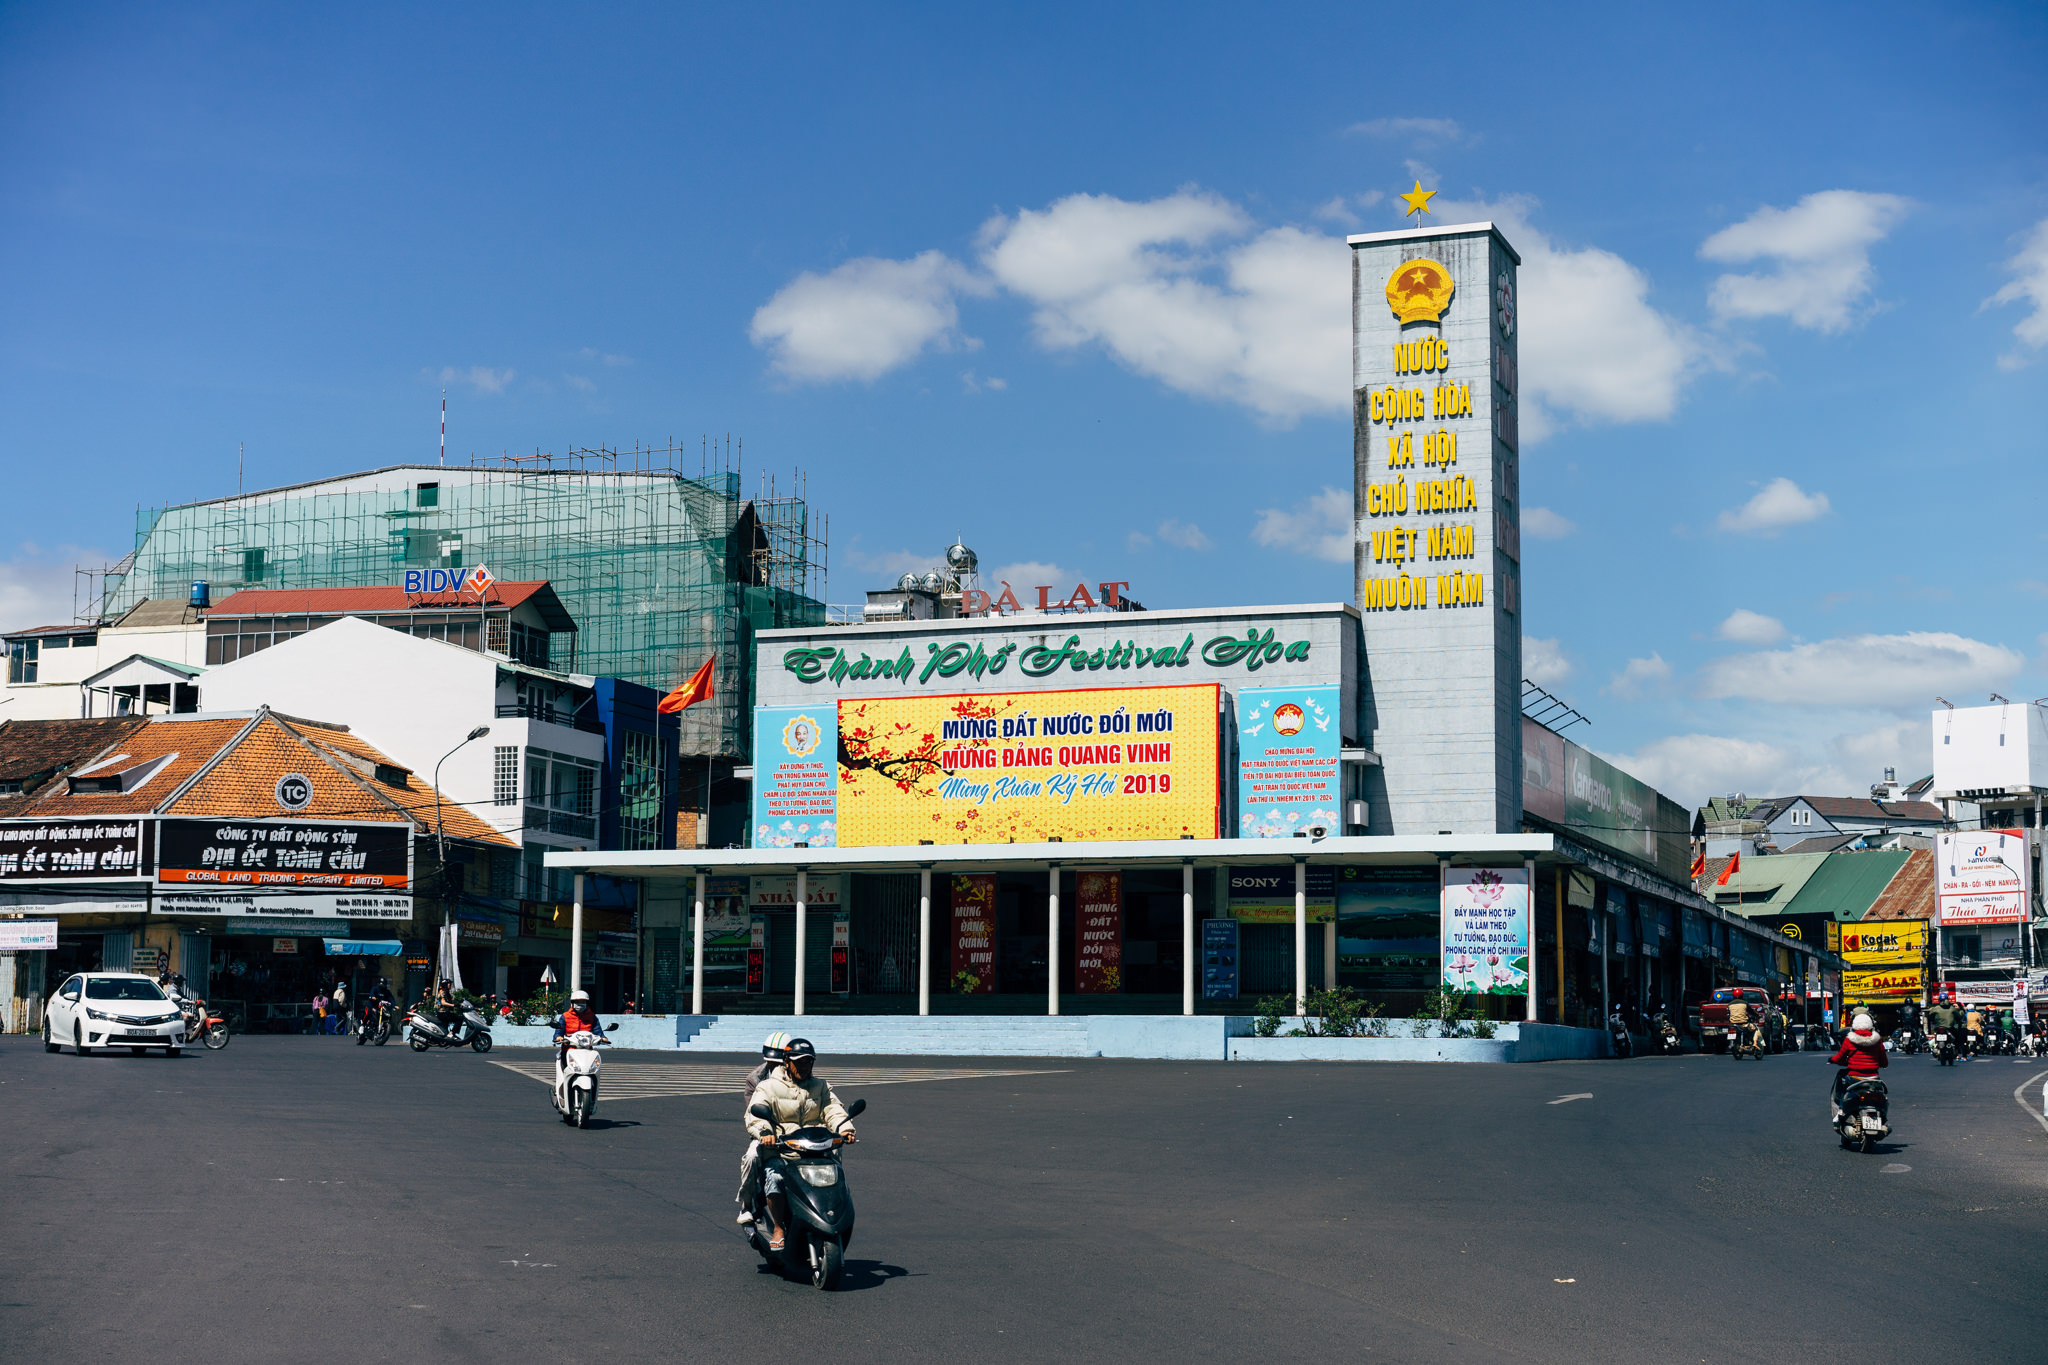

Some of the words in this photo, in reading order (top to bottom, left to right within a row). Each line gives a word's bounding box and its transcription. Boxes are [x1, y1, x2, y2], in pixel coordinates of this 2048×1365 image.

[1394, 334, 1448, 373] NƯỚC
[1371, 385, 1424, 426] CỘNG
[1433, 379, 1472, 417] HÒA
[1387, 430, 1414, 466] XÃ
[1423, 427, 1456, 468] HỘI
[1368, 473, 1407, 514] CHỦ
[1416, 473, 1476, 511] NGHĨA
[1371, 525, 1416, 566] VIỆT
[1427, 525, 1474, 557] NAM
[404, 568, 468, 593] BIDV
[1365, 571, 1426, 608] MUÔN
[1437, 568, 1482, 605] NĂM
[958, 580, 1024, 614] ĐÀ
[1035, 581, 1129, 614] LẠT
[783, 644, 915, 688] Thành
[919, 641, 1017, 682] Phố
[1019, 632, 1193, 674] Festival
[1201, 627, 1310, 671] Hoa
[943, 717, 997, 739] MỪNG
[1002, 710, 1037, 738] ĐẤT
[1043, 711, 1094, 736] NƯỚC
[1099, 706, 1130, 733] ĐỔI
[1136, 708, 1173, 732] MỚI
[942, 745, 997, 769] MỪNG
[1002, 741, 1052, 768] ĐẢNG
[1059, 745, 1121, 768] QUANG
[1127, 742, 1171, 763] VINH
[1265, 747, 1278, 756] CHÀO
[1280, 747, 1295, 755] MỪNG
[1296, 747, 1305, 755] ĐẠI
[1306, 746, 1315, 754] HỘI
[811, 761, 823, 769] THỨC
[1241, 759, 1252, 769] MẶT
[1253, 759, 1267, 768] TRẬN
[1268, 758, 1274, 767] TỔ
[1275, 758, 1289, 767] QUỐC
[1290, 758, 1301, 767] VIỆT
[1315, 757, 1326, 766] CÁC
[1326, 756, 1337, 765] CẤP
[784, 772, 801, 780] TRỌNG
[802, 771, 816, 779] NHÂN
[1243, 770, 1255, 780] TIẾN
[1256, 771, 1264, 779] TỚI
[1265, 771, 1274, 780] ĐẠI
[1275, 771, 1284, 780] HỘI
[1284, 771, 1293, 779] ĐẠI
[1294, 768, 1306, 778] BIỂU
[1307, 769, 1320, 778] TOÀN
[1321, 768, 1336, 778] QUỐC
[777, 780, 790, 788] PHÁT
[802, 780, 814, 788] DÂN
[938, 776, 990, 804] Mừng
[993, 776, 1042, 802] Xuân
[1046, 774, 1079, 805] Kỷ
[1080, 771, 1118, 799] Hợi
[1123, 774, 1171, 795] 2019
[1253, 783, 1264, 792] MẶT
[1265, 782, 1279, 791] TRẬN
[1280, 781, 1286, 790] TỔ
[1287, 781, 1301, 790] QUỐC
[1302, 781, 1313, 790] VIỆT
[1314, 782, 1326, 790] NAM
[1569, 756, 1612, 813] Kangaroo
[283, 785, 306, 800] TC
[763, 790, 779, 798] CHĂM
[797, 789, 811, 797] SỐNG
[812, 789, 827, 797] NHÂN
[1247, 794, 1257, 804] LẦN
[1258, 794, 1268, 803] THỨ
[1277, 794, 1294, 803] NHIỆM
[1302, 794, 1315, 802] 2019
[809, 799, 820, 807] ĐẠO
[787, 808, 800, 816] CÁCH
[802, 807, 808, 815] HỒ
[810, 807, 819, 815] CHÍ
[4, 830, 18, 841] GIAO
[19, 830, 34, 843] DỊCH
[35, 825, 49, 841] BẤT
[49, 826, 67, 843] ĐỘNG
[68, 825, 81, 840] SẢN
[82, 828, 94, 842] ĐỊA
[94, 824, 104, 839] ỐC
[105, 824, 122, 839] TOÀN
[122, 823, 137, 838] CẦU
[216, 826, 248, 841] CÔNG
[251, 829, 267, 841] TY
[269, 826, 293, 842] BẤT
[295, 828, 329, 845] ĐỘNG
[21, 846, 47, 872] ỐC
[51, 847, 97, 872] TOÀN
[101, 844, 136, 870] CẦU
[202, 846, 236, 871] ĐỊA
[241, 842, 268, 867] ỐC
[275, 846, 323, 869] TOÀN
[328, 845, 367, 870] CẦU
[186, 872, 221, 881] GLOBAL
[227, 873, 252, 882] LAND
[258, 874, 296, 883] TRADING
[302, 875, 343, 884] COMPANY
[349, 876, 384, 886] LIMITED
[1232, 877, 1280, 888] SONY
[1972, 879, 1981, 888] GỐI
[1985, 880, 1996, 889] NỆM
[758, 889, 794, 904] NHÀ
[955, 905, 982, 918] MỪNG
[1084, 902, 1117, 912] MỪNG
[1454, 905, 1467, 917] ĐẨY
[1469, 908, 1487, 919] MẠNH
[1488, 908, 1502, 919] HỌC
[1504, 907, 1516, 919] TẬP
[1090, 914, 1112, 926] ĐẤT
[1465, 920, 1473, 930] VÀ
[1475, 920, 1488, 930] LÀM
[1490, 921, 1507, 930] THEO
[1083, 930, 1115, 941] NƯỚC
[1454, 932, 1463, 942] TƯ
[1488, 933, 1502, 944] ĐẠO
[1861, 933, 1898, 946] Kodak
[959, 936, 989, 950] QUANG
[1082, 942, 1103, 955] ĐỔI
[1445, 946, 1467, 955] PHONG
[1468, 944, 1486, 955] CÁCH
[1487, 943, 1496, 955] HỒ
[1498, 944, 1509, 955] CHÍ
[1510, 946, 1527, 956] MINH
[833, 948, 847, 965] NHÀ
[970, 952, 993, 964] VINH
[1079, 957, 1101, 968] MỚI
[1872, 977, 1917, 988] DALAT
